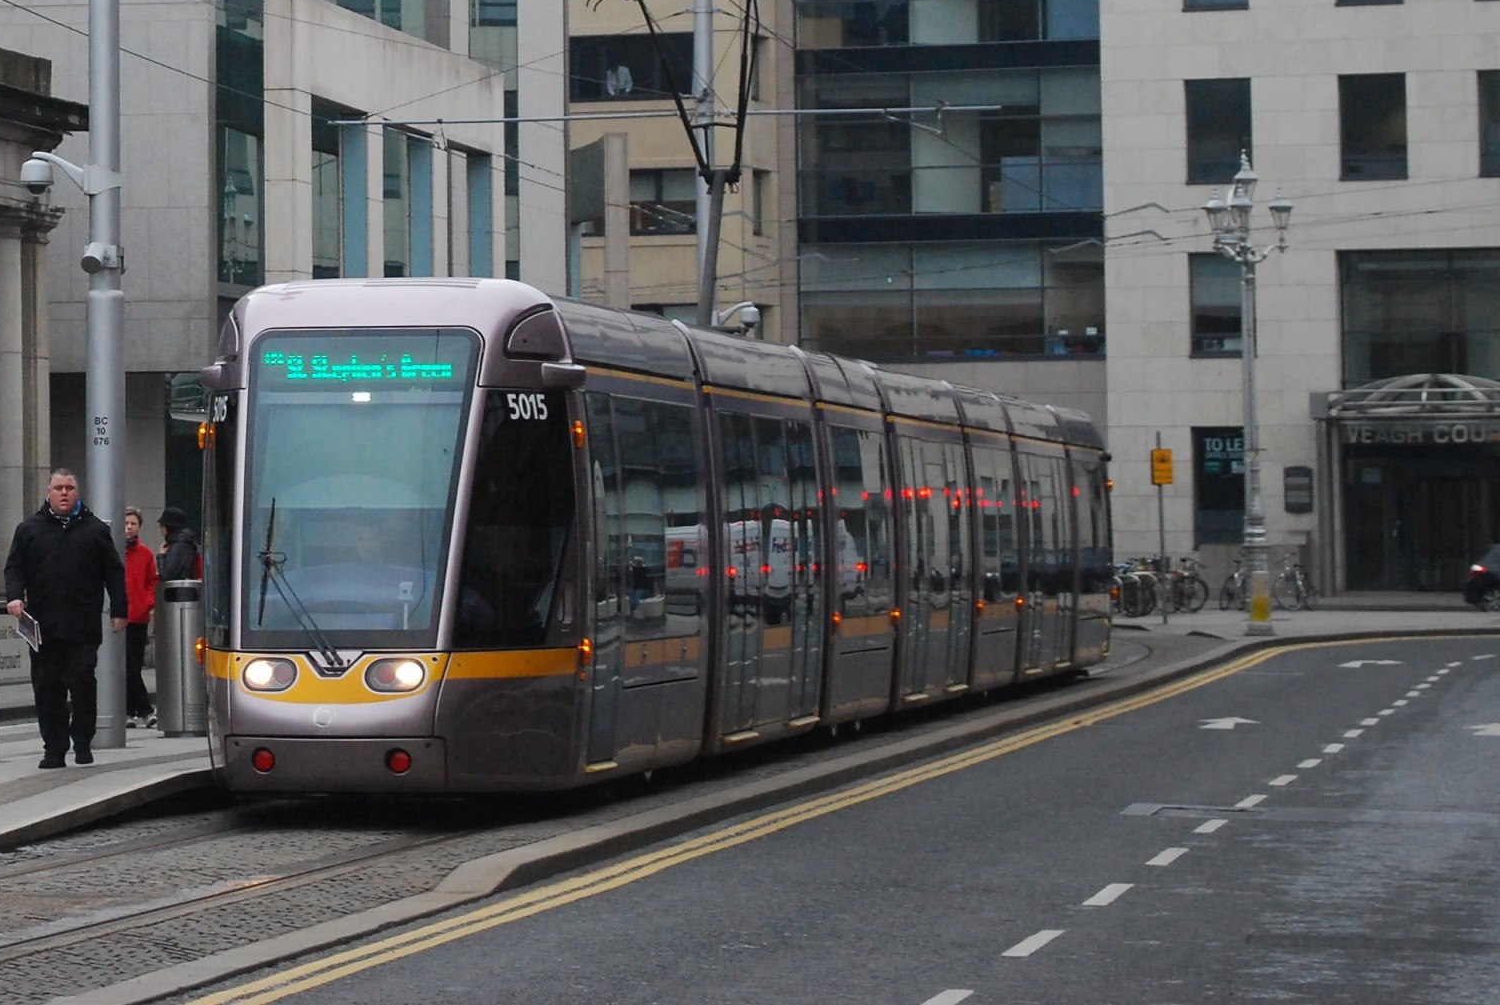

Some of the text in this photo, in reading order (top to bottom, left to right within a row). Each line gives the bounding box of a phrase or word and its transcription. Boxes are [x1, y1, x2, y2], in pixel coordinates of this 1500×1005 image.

[401, 354, 452, 379] Green
[506, 393, 548, 420] 5015
[94, 417, 108, 425] BC
[97, 427, 106, 435] 10
[1433, 424, 1500, 444] COU
[93, 437, 110, 446] 676
[1204, 437, 1243, 451] TO LE
